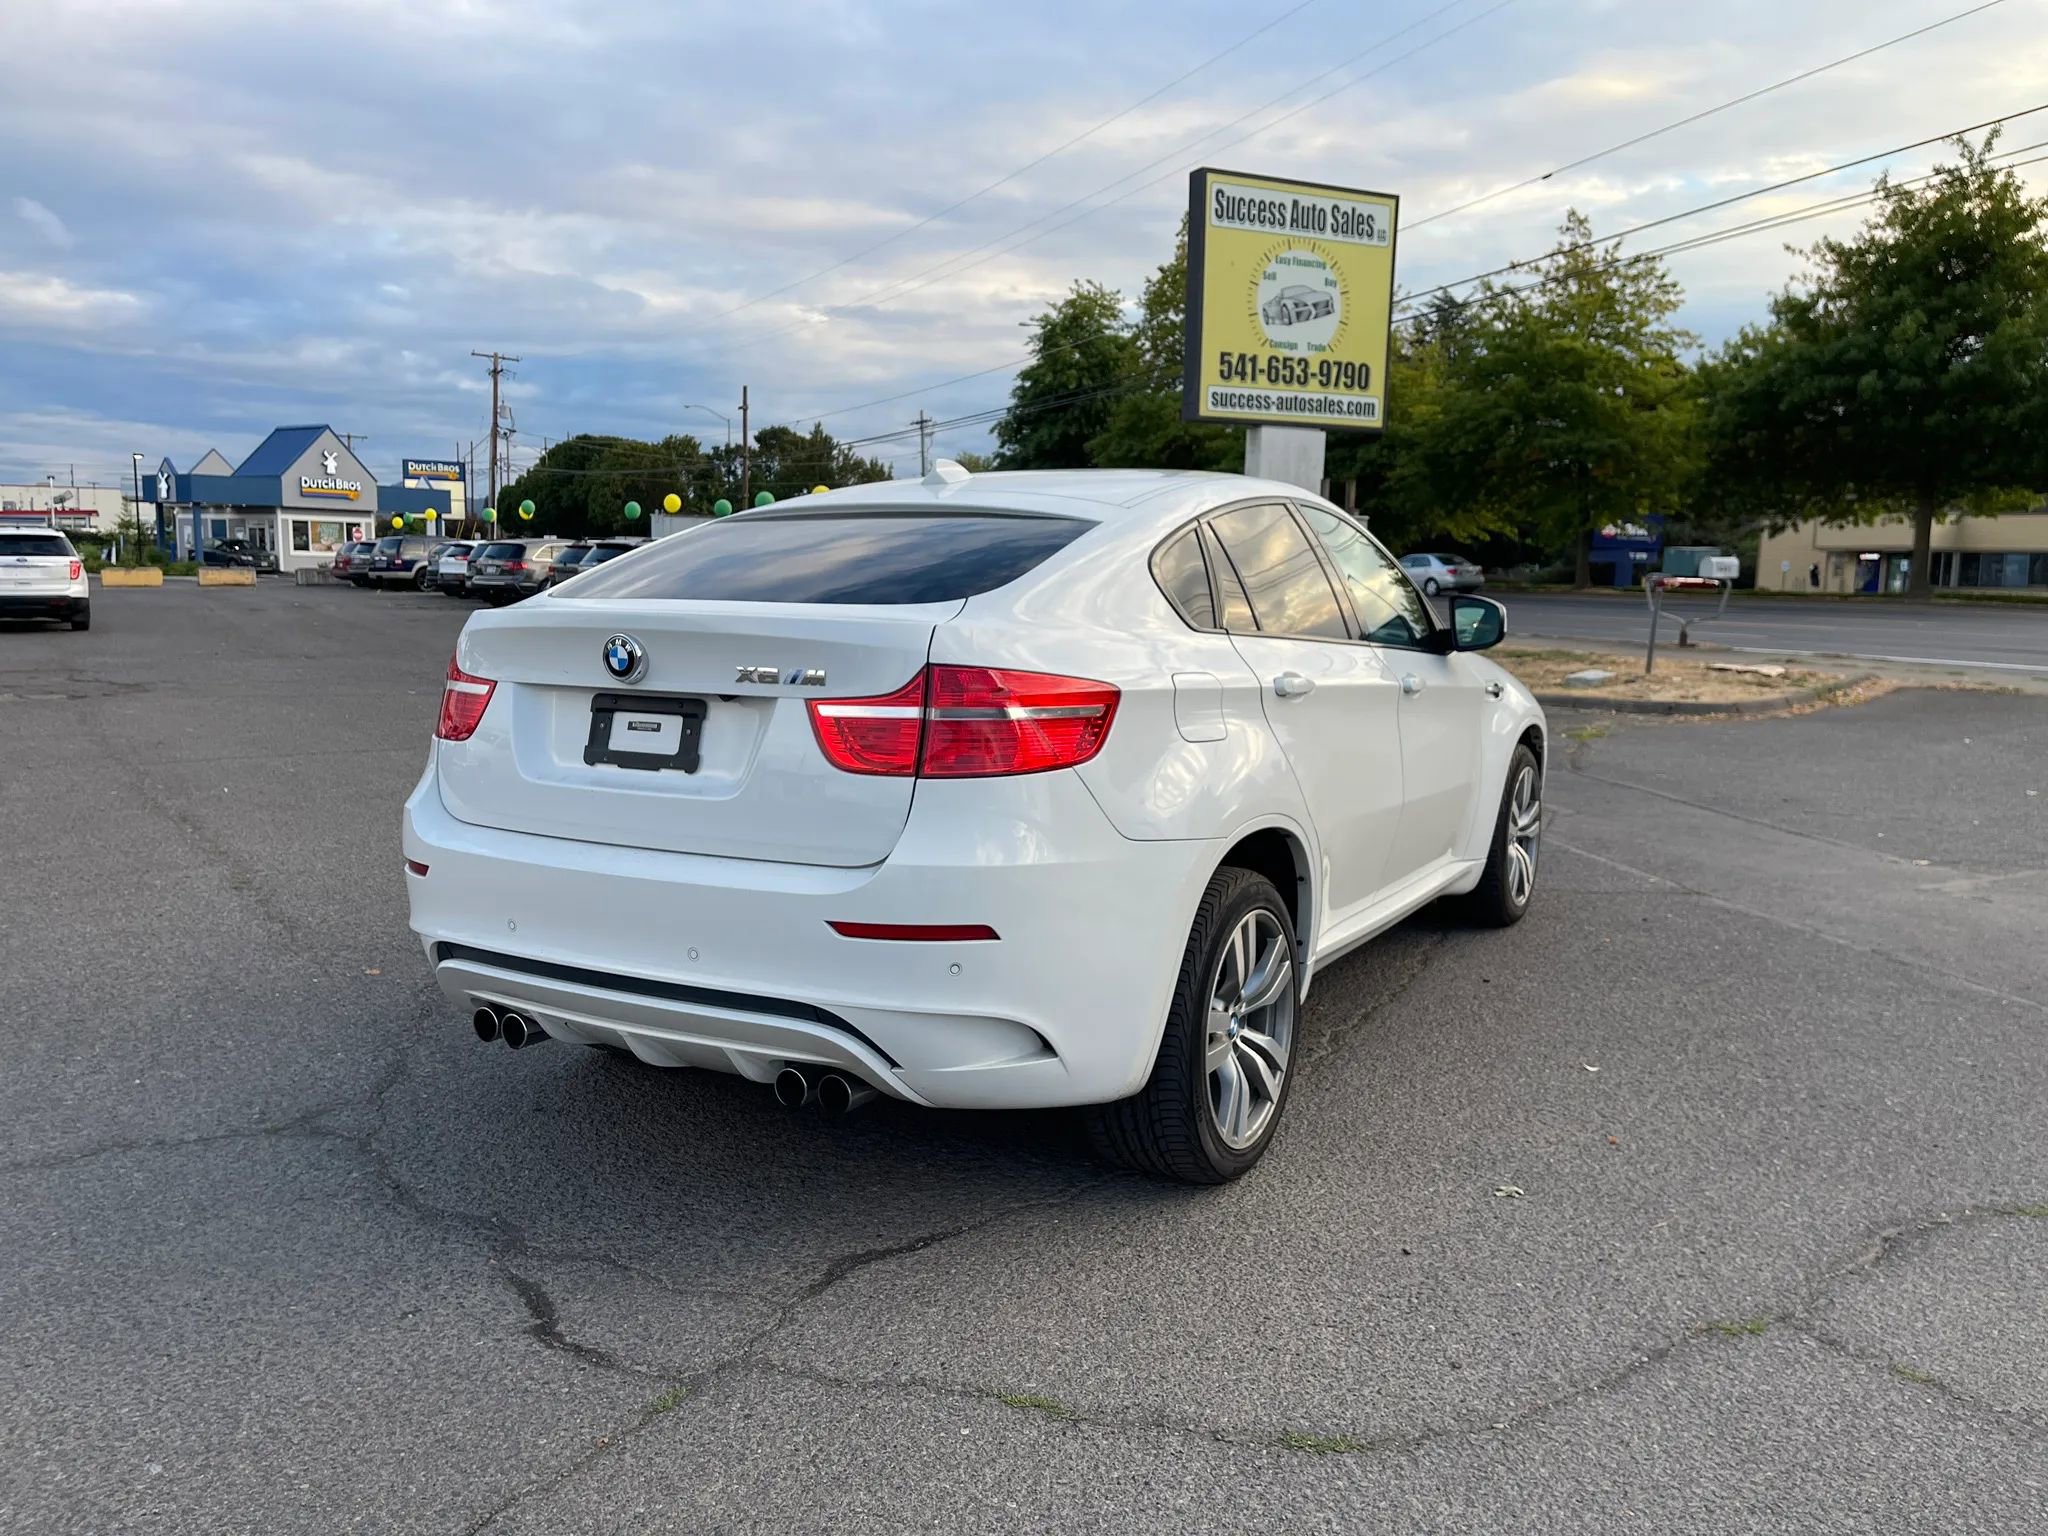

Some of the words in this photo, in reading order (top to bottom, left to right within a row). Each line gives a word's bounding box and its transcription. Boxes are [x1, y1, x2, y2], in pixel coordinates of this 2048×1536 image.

[1215, 188, 1286, 228] Success
[1290, 199, 1326, 233] Auto
[1331, 204, 1375, 239] Sales
[1275, 255, 1291, 266] Easy
[1292, 256, 1326, 270] Financing
[1263, 270, 1277, 281] Sell
[1324, 277, 1337, 288] Buy
[1269, 339, 1298, 351] Consign
[1307, 342, 1327, 352] Trade
[1219, 351, 1370, 390] 541-653-9790
[1211, 392, 1376, 417] success-autosales.com
[607, 638, 632, 652] BMW
[735, 665, 780, 685] X6
